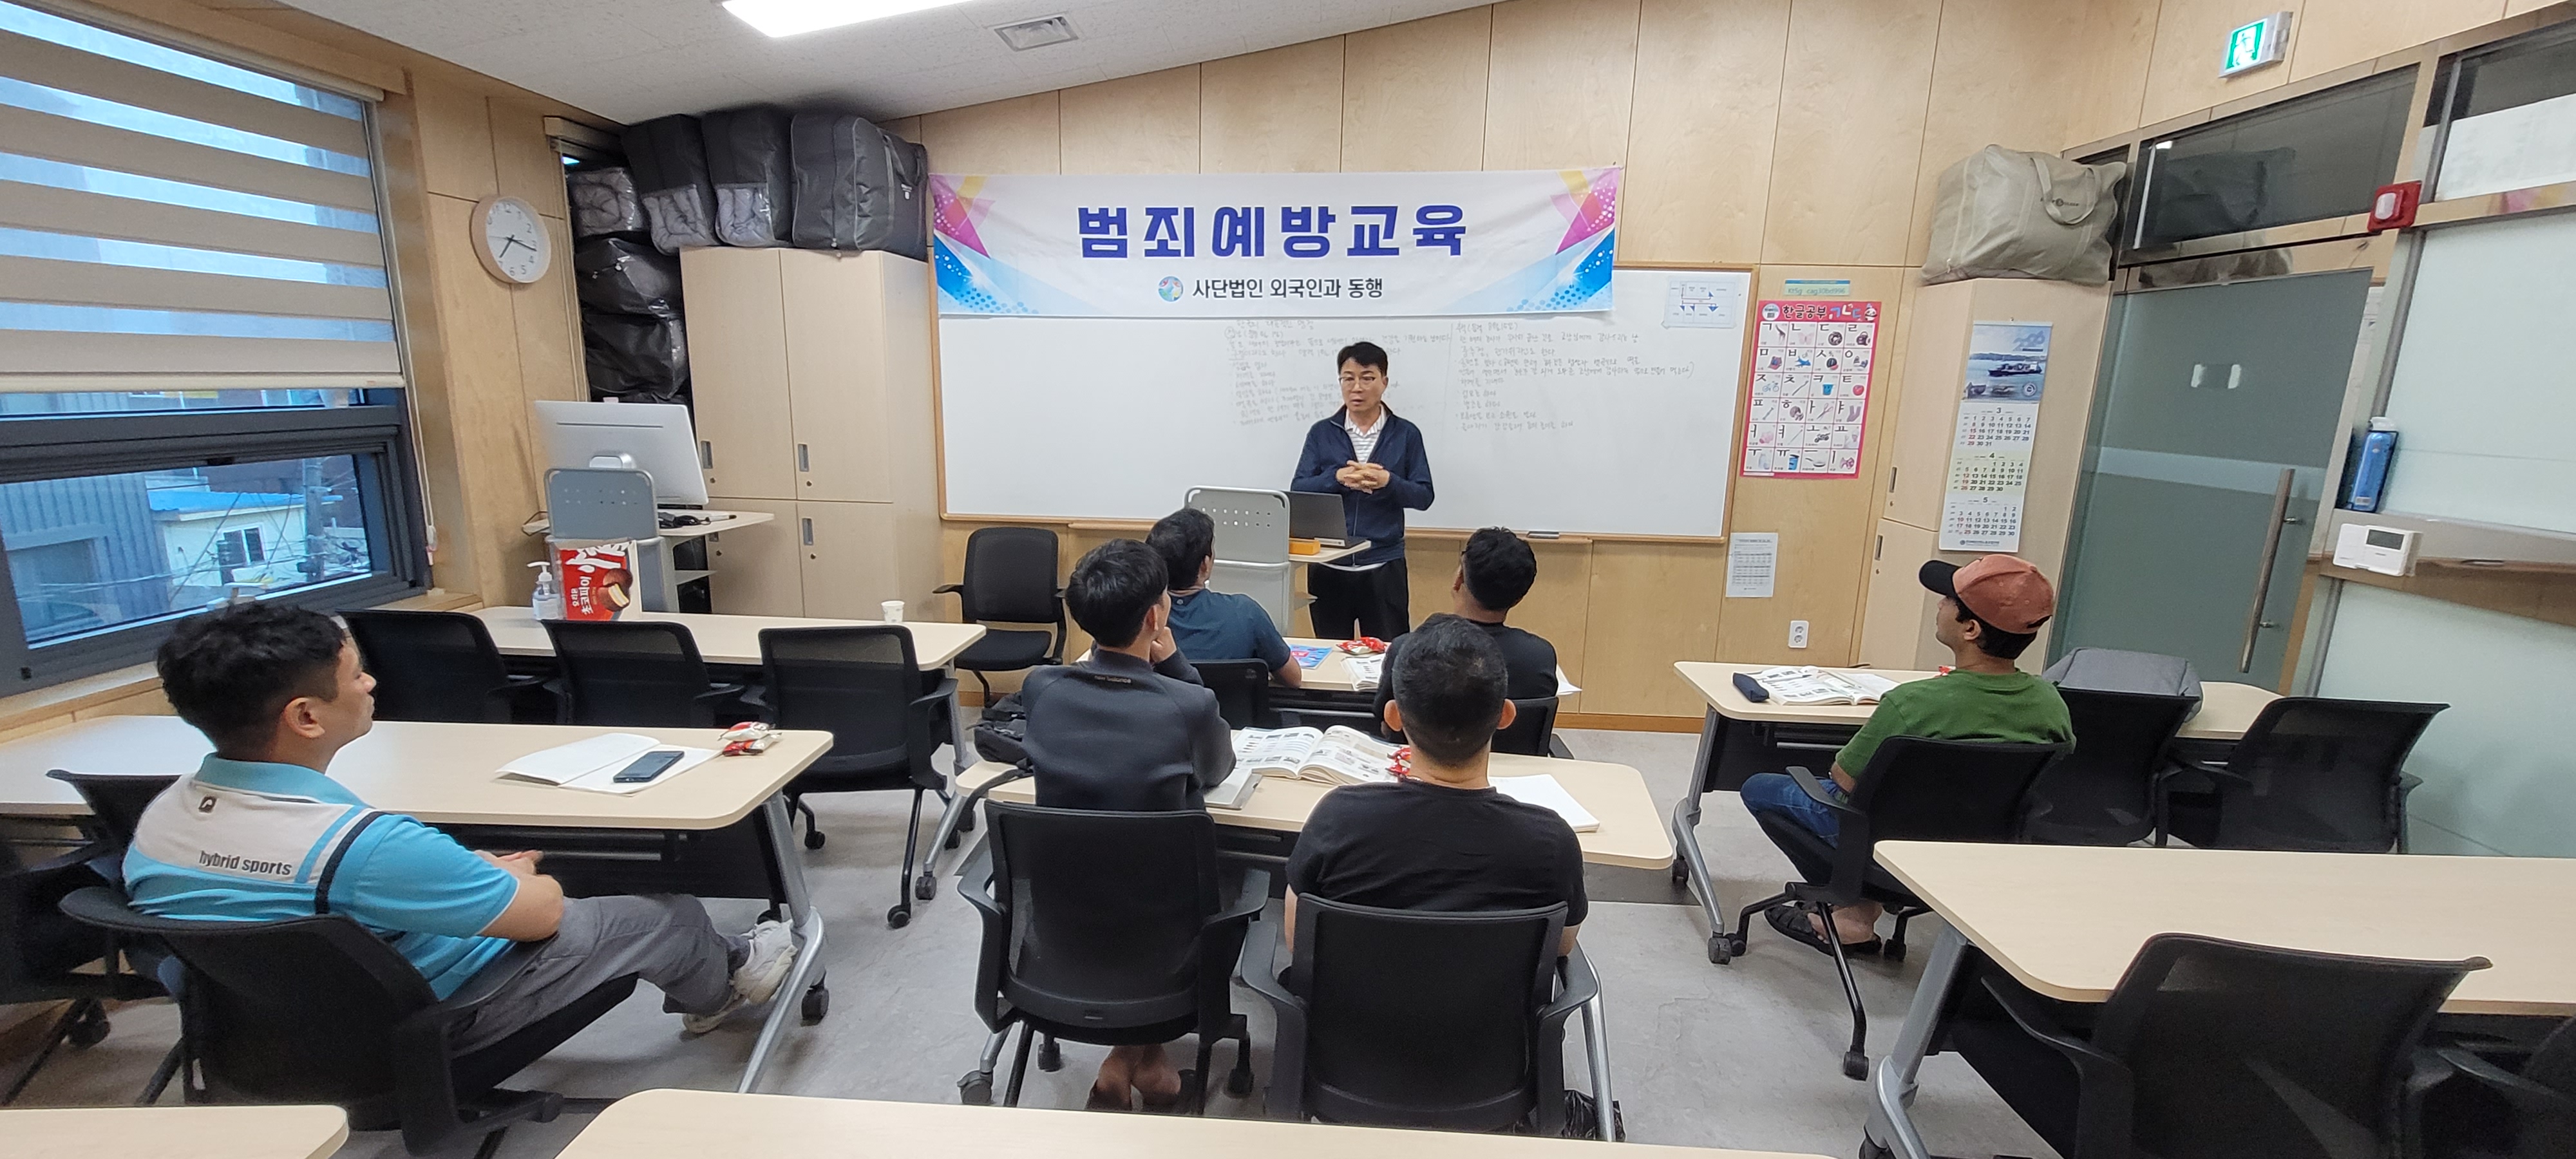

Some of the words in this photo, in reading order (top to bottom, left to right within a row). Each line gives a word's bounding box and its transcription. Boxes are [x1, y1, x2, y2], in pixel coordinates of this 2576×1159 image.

[1078, 205, 1466, 258] 범죄예방교육
[1192, 278, 1264, 299] 사단법인
[1270, 278, 1341, 299] 외국인과
[1348, 278, 1383, 298] 동행
[1783, 304, 1826, 319] 한글공부
[1844, 350, 1853, 358] ㅇ
[1784, 374, 1795, 383] ㅊ
[1781, 399, 1792, 408] ㅎ
[1810, 400, 1815, 414] ㅏ
[1838, 400, 1844, 415] ㅑ
[1750, 424, 1757, 438] ㅓ
[1779, 425, 1785, 438] ㅕ
[578, 576, 594, 616] 초코파이
[199, 850, 240, 869] hybrid
[242, 859, 292, 876] sports
